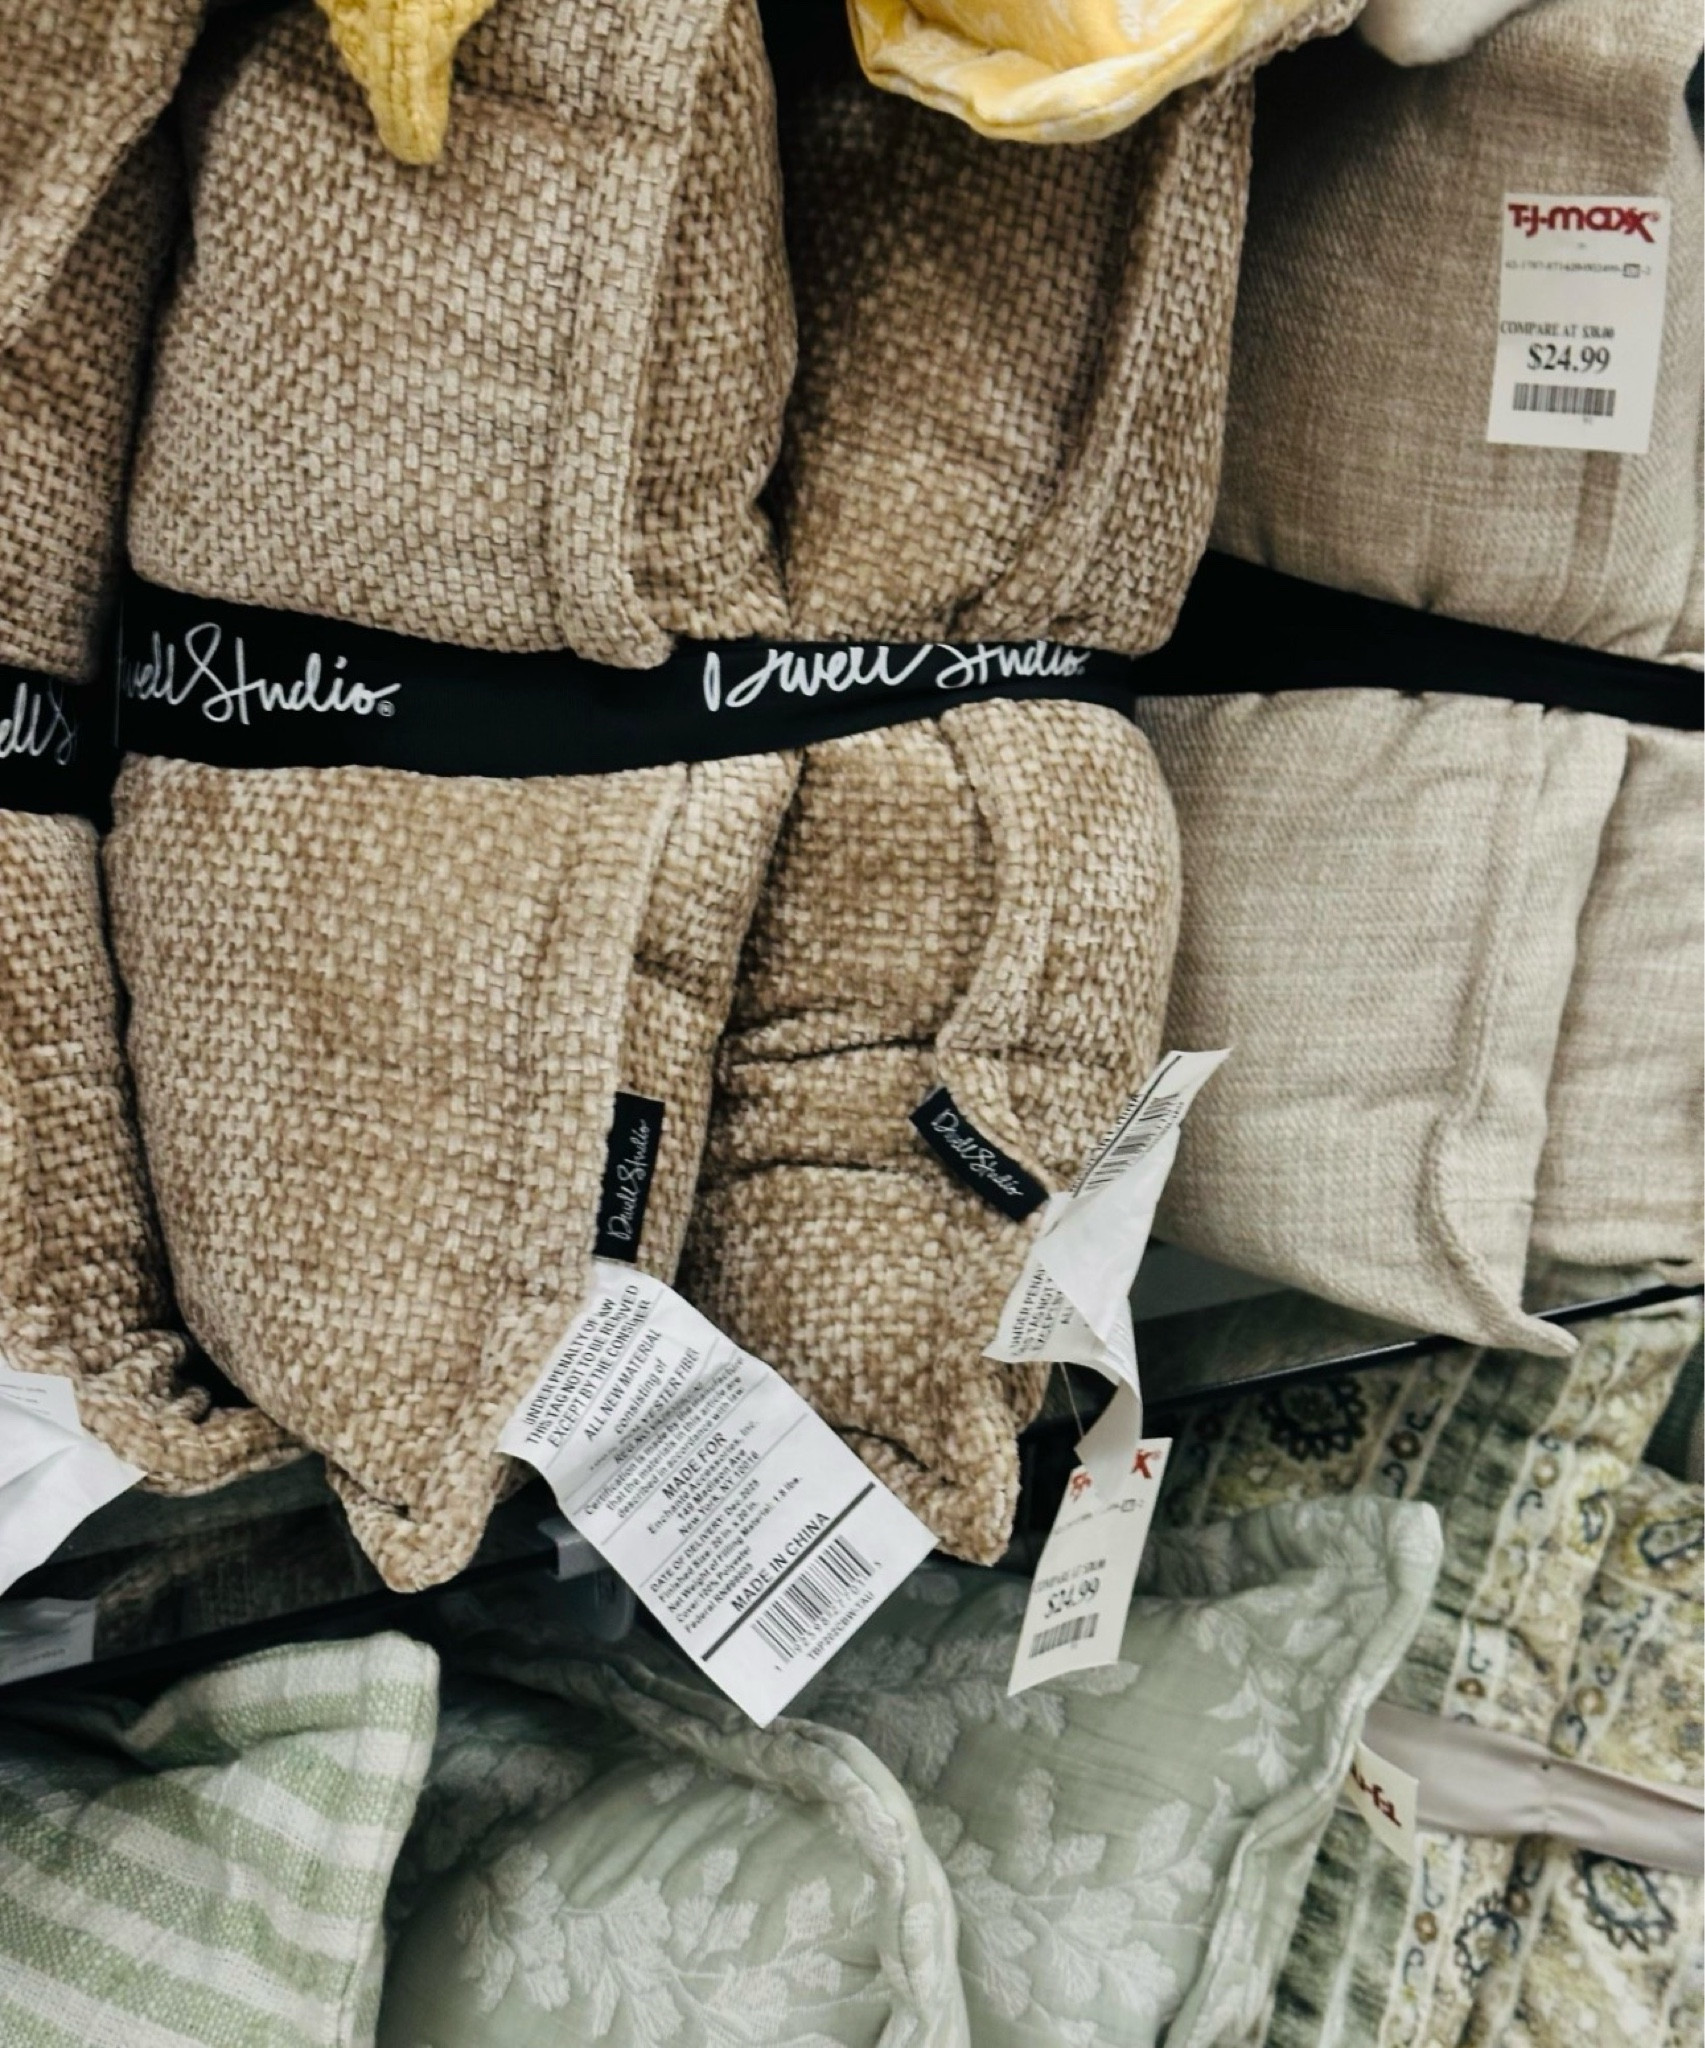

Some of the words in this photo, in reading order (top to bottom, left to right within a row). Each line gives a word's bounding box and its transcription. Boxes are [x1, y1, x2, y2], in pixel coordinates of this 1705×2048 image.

[1527, 343, 1611, 374] $24.99
[526, 1384, 556, 1424] UNDER
[547, 1333, 588, 1383] PENALTY
[581, 1319, 598, 1332] OF
[526, 1420, 553, 1444] THIS
[546, 1394, 568, 1417] TAG
[560, 1369, 585, 1394] NOT
[577, 1352, 596, 1367] TO
[587, 1339, 606, 1351] BE
[547, 1398, 585, 1446] EXCEPT
[578, 1380, 597, 1398] BY
[590, 1360, 612, 1380] THE
[584, 1416, 605, 1441] ALL
[600, 1384, 625, 1416] NEW
[618, 1329, 662, 1387] MATERIAL
[614, 1373, 662, 1434] consisting
[654, 1358, 667, 1374] of
[584, 1463, 637, 1515] Certification
[644, 1432, 668, 1456] made
[676, 1406, 692, 1421] the
[606, 1491, 627, 1511] that
[623, 1478, 640, 1494] the
[638, 1440, 678, 1480] materials
[662, 1459, 701, 1500] MADE
[697, 1432, 727, 1463] FOR
[692, 1466, 730, 1505] Madison
[728, 1449, 746, 1467] Ave
[678, 1517, 700, 1536] New
[719, 1479, 734, 1492] NY
[650, 1569, 674, 1593] DATE
[673, 1556, 684, 1570] OF
[667, 1596, 684, 1612] Net
[681, 1569, 711, 1598] Weight
[709, 1559, 719, 1571] of
[730, 1569, 770, 1612] MADE
[769, 1553, 788, 1572] IN
[785, 1513, 830, 1556] CHINA
